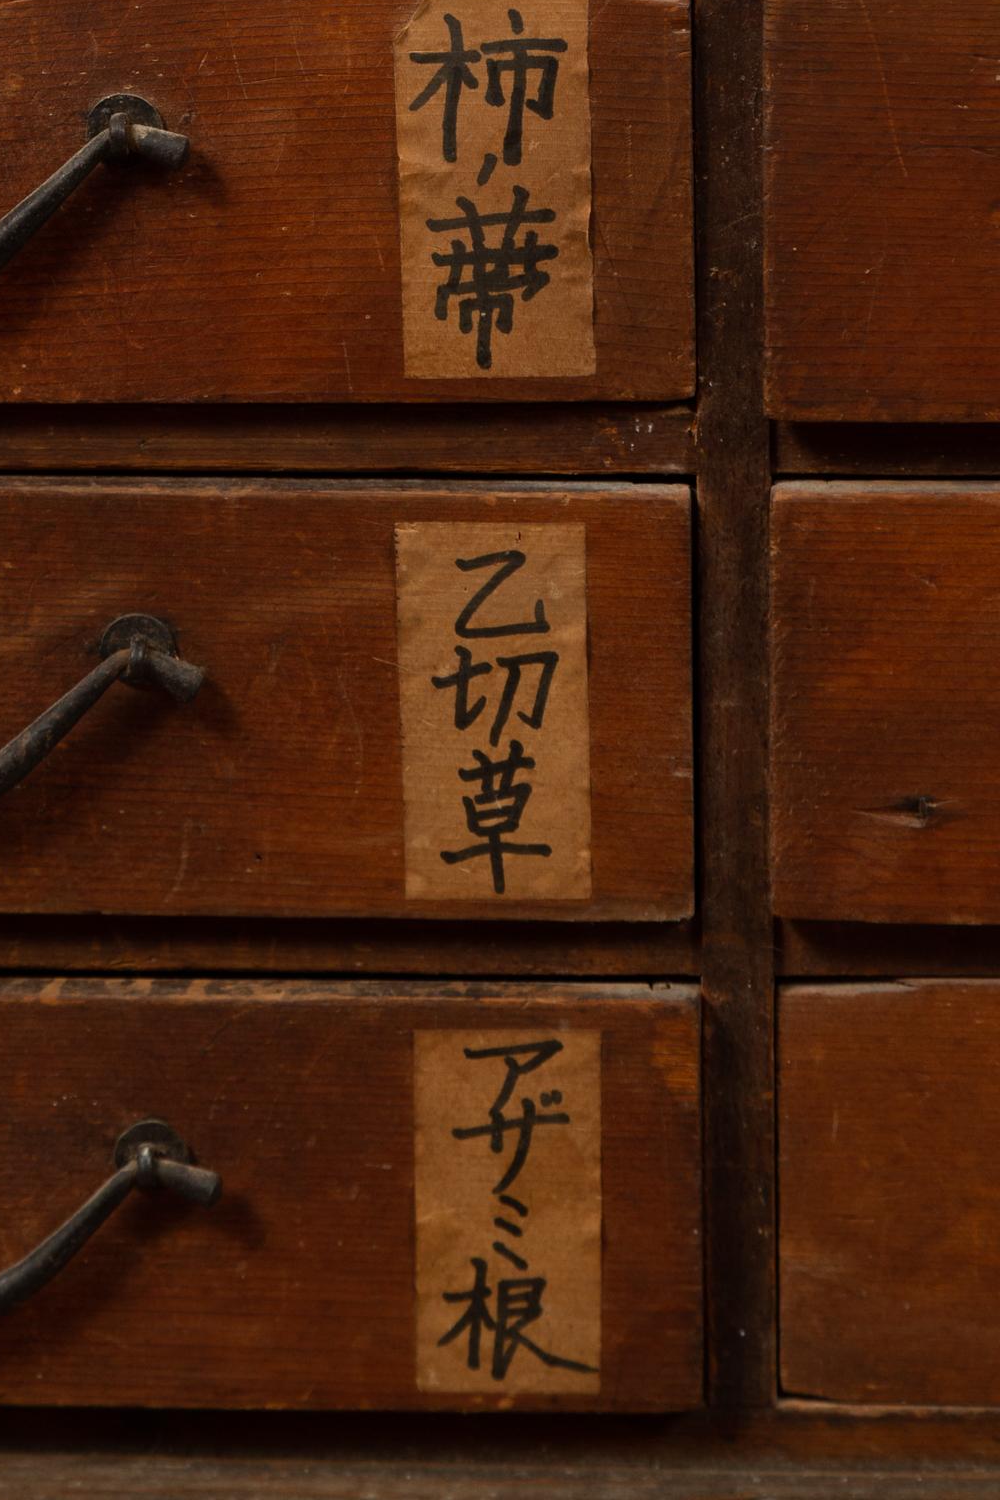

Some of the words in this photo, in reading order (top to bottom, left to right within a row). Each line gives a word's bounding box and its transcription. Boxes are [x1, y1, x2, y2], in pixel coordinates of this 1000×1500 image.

[431, 550, 560, 894] 乙切草
[438, 1040, 599, 1380] アザミ根
